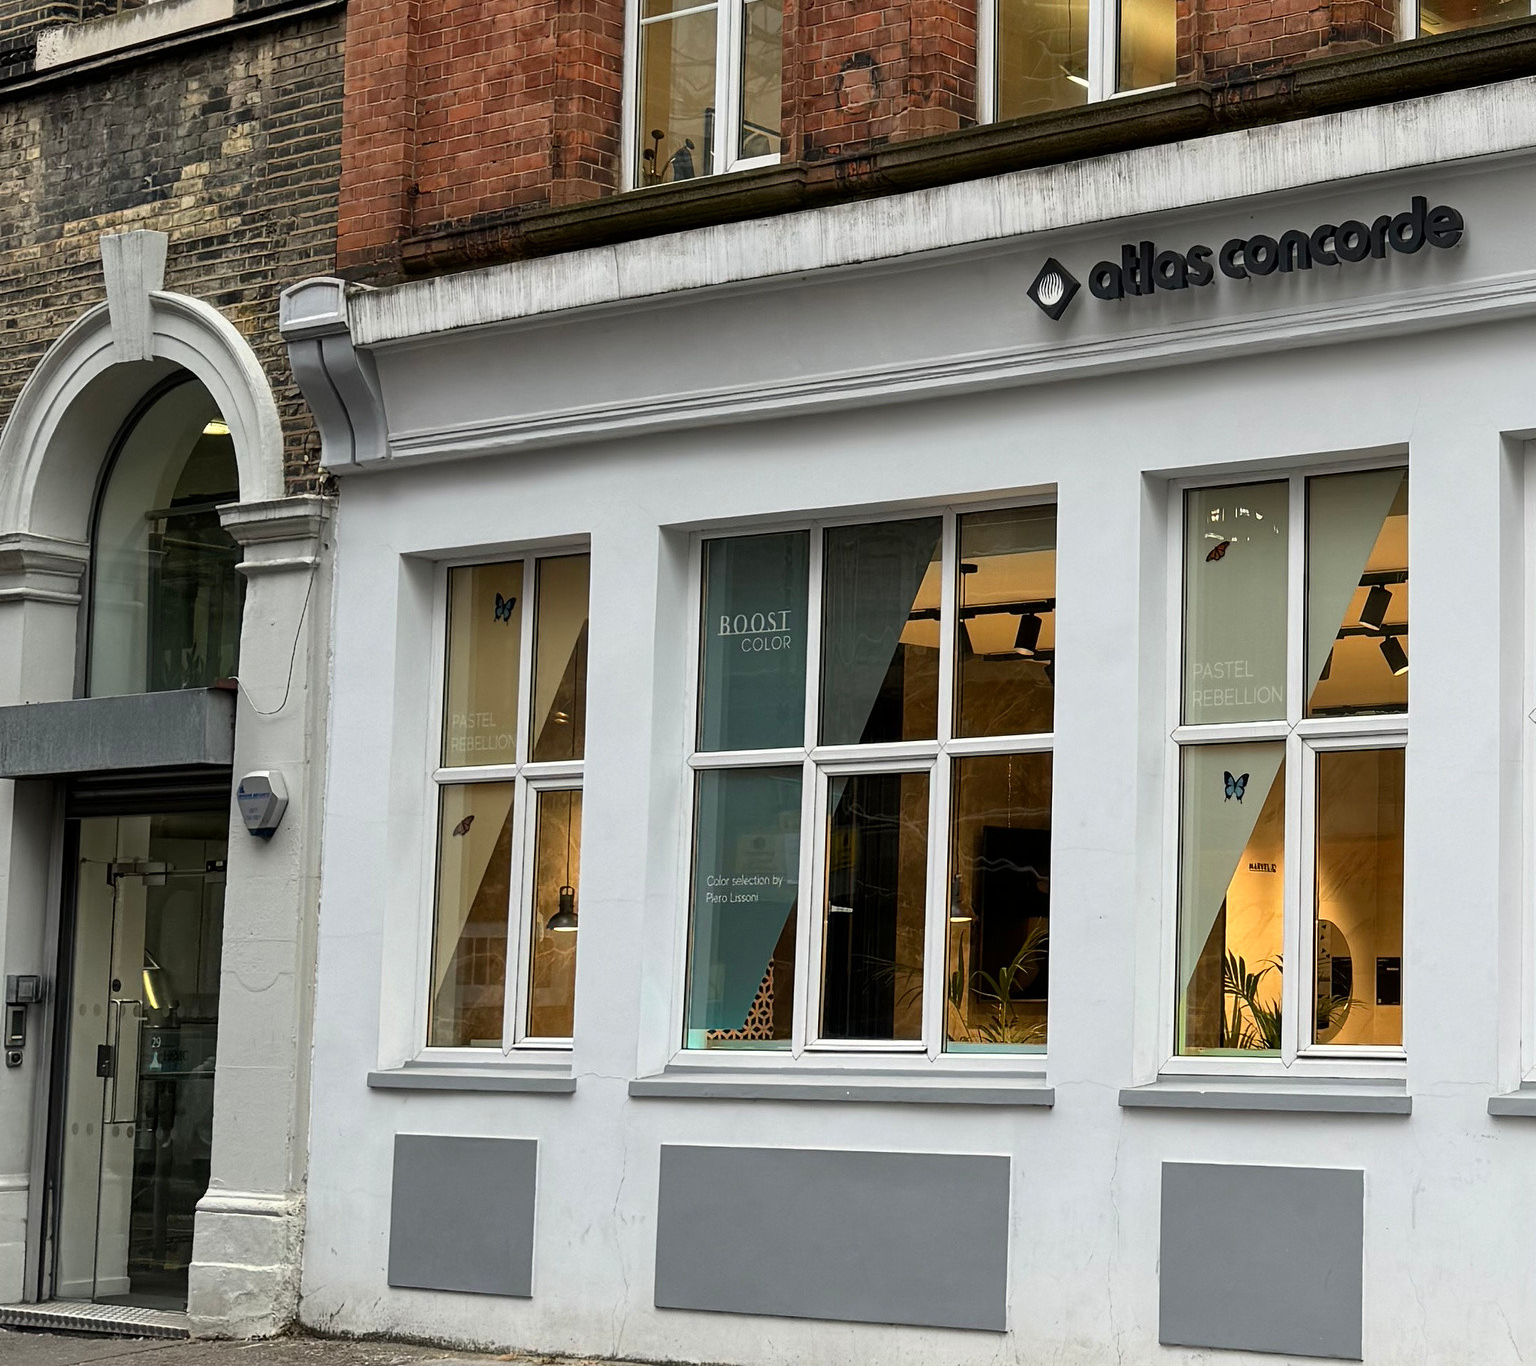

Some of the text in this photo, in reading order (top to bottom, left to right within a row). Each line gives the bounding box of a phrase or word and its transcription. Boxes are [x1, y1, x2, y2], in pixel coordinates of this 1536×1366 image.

[1088, 195, 1464, 301] atlas concorde
[717, 610, 792, 637] BOOST
[741, 635, 792, 653] COLOR
[1193, 660, 1254, 680] PASTEL
[1193, 685, 1283, 708] REBELLION
[453, 712, 497, 729] PASTEL
[706, 874, 784, 888] Color selection by
